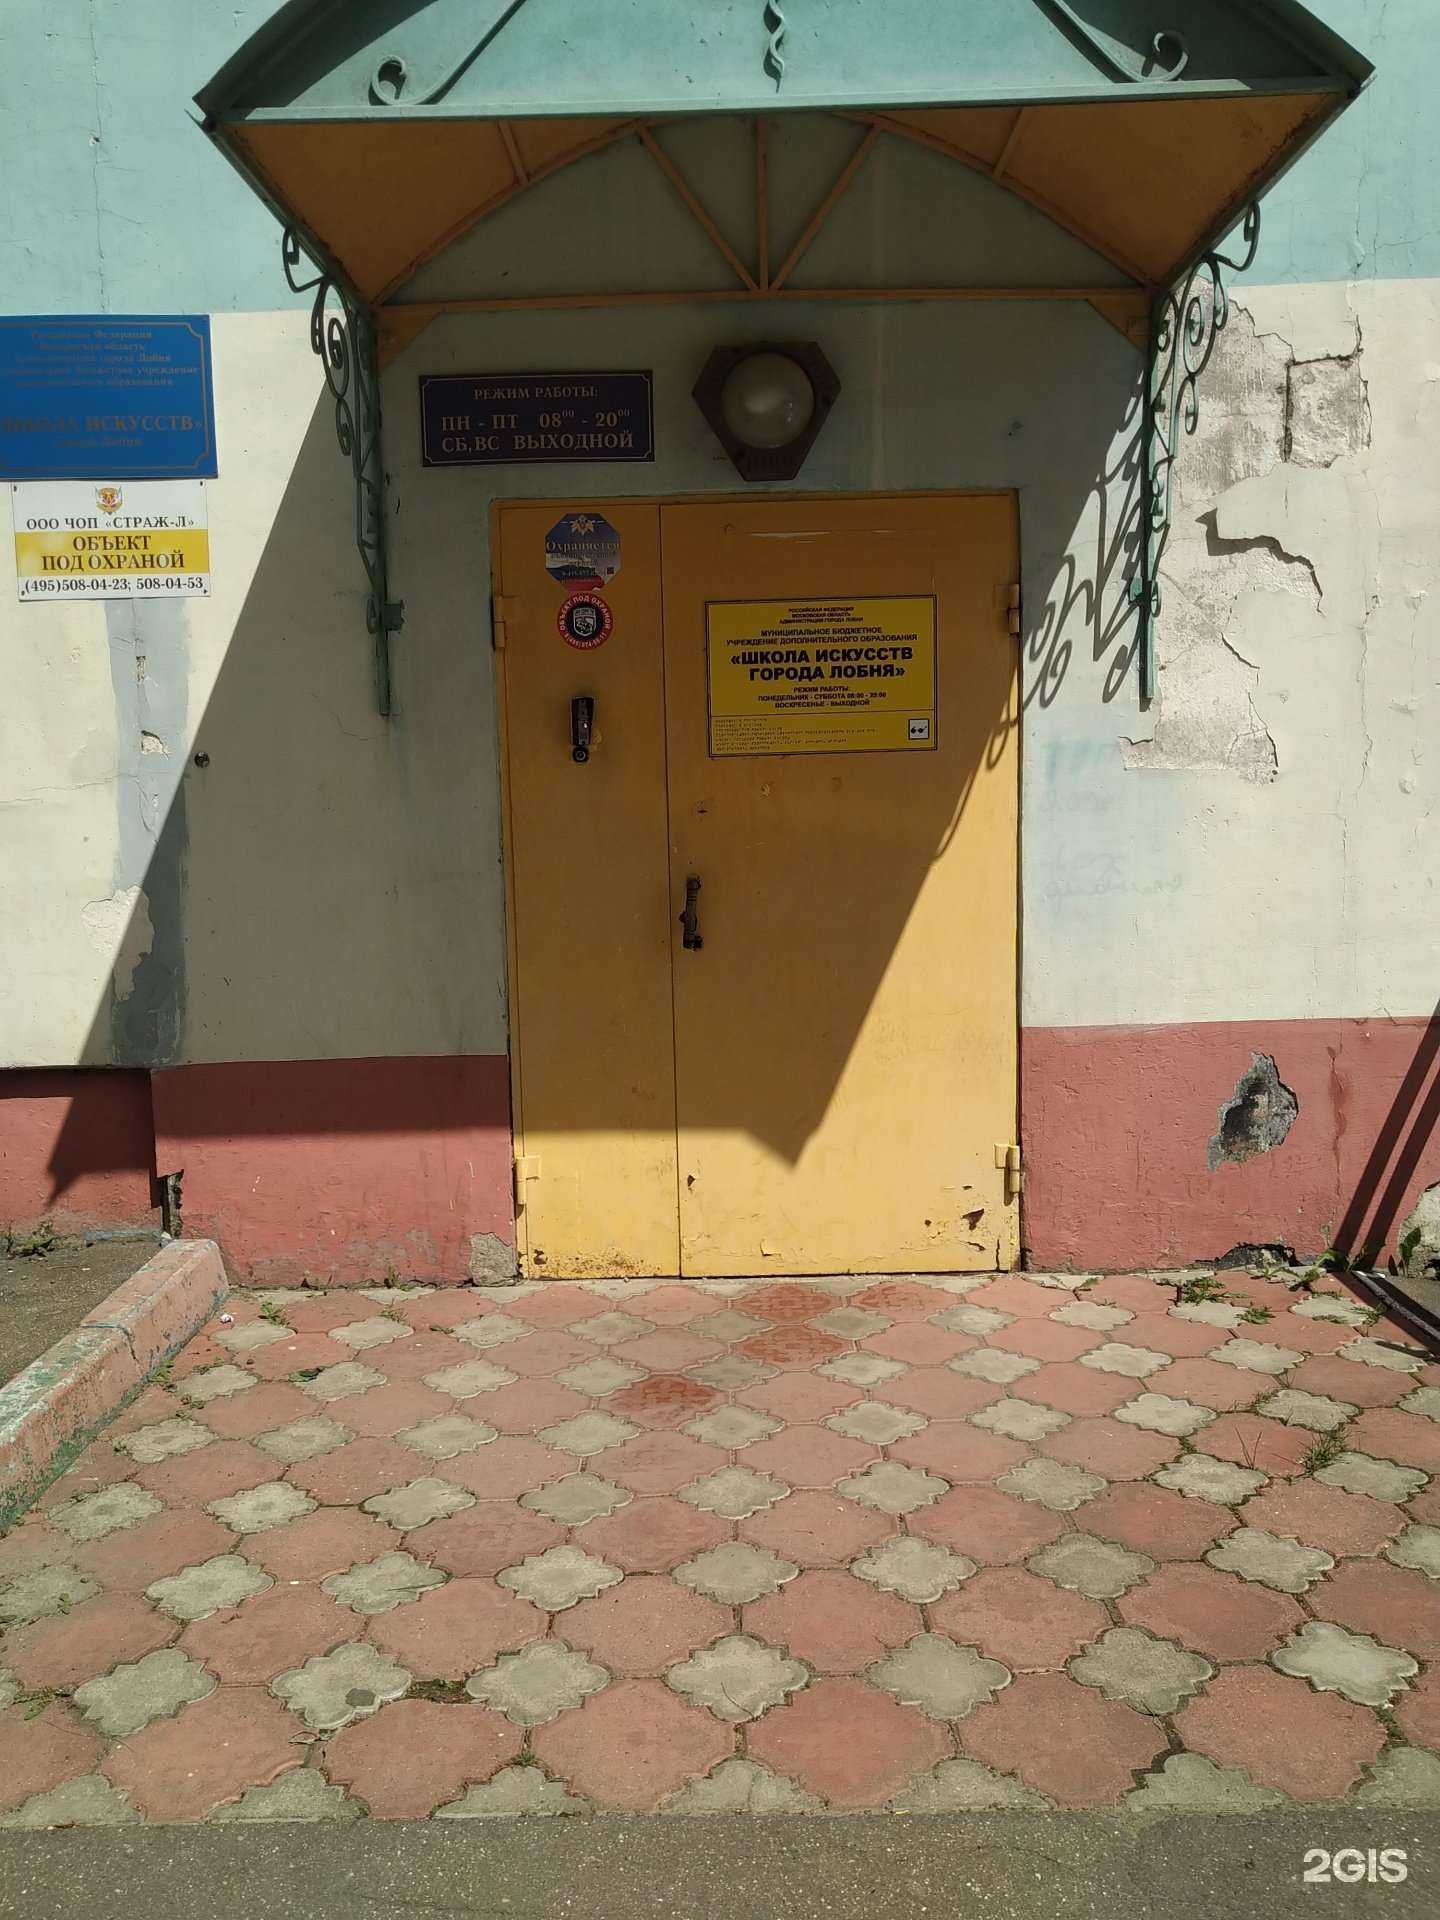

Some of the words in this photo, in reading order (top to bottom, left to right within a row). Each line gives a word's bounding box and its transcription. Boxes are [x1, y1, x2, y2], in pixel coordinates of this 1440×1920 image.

[472, 387, 529, 400] РЕЖИМ
[440, 415, 471, 431] ПН
[491, 413, 519, 429] ПТ
[512, 428, 634, 452] ВЫХОДНОЙ
[26, 518, 59, 530] ООО
[65, 517, 98, 529] ЧОП
[73, 535, 151, 551] ОБЪЕКТ
[41, 555, 84, 572] ПОД
[88, 549, 186, 570] ОХРАНОЙ
[25, 578, 131, 593] (495)508-04-23;
[136, 577, 204, 590] 508-04-53
[572, 594, 590, 602] ПОД
[761, 627, 831, 637] МУНИЦИПАЛЬНОЕ
[832, 626, 882, 635] БЮДЖЕТНОЕ
[726, 638, 778, 646] УЧРЕЖДЕНИЕ
[779, 636, 859, 646] ДОПОЛНИТЕЛЬНОГО
[860, 634, 918, 643] ОБРАЗОВАНИЯ
[731, 649, 810, 665] «ШКОЛА
[815, 646, 913, 663] ИСКУССТВ
[749, 667, 824, 682] ГОРОДА
[830, 663, 906, 679] ЛОБНЯ»
[758, 694, 809, 702] ПОНЕДЕЛЬНИК
[775, 700, 825, 708] ВОСКРЕСЕНЬЕ
